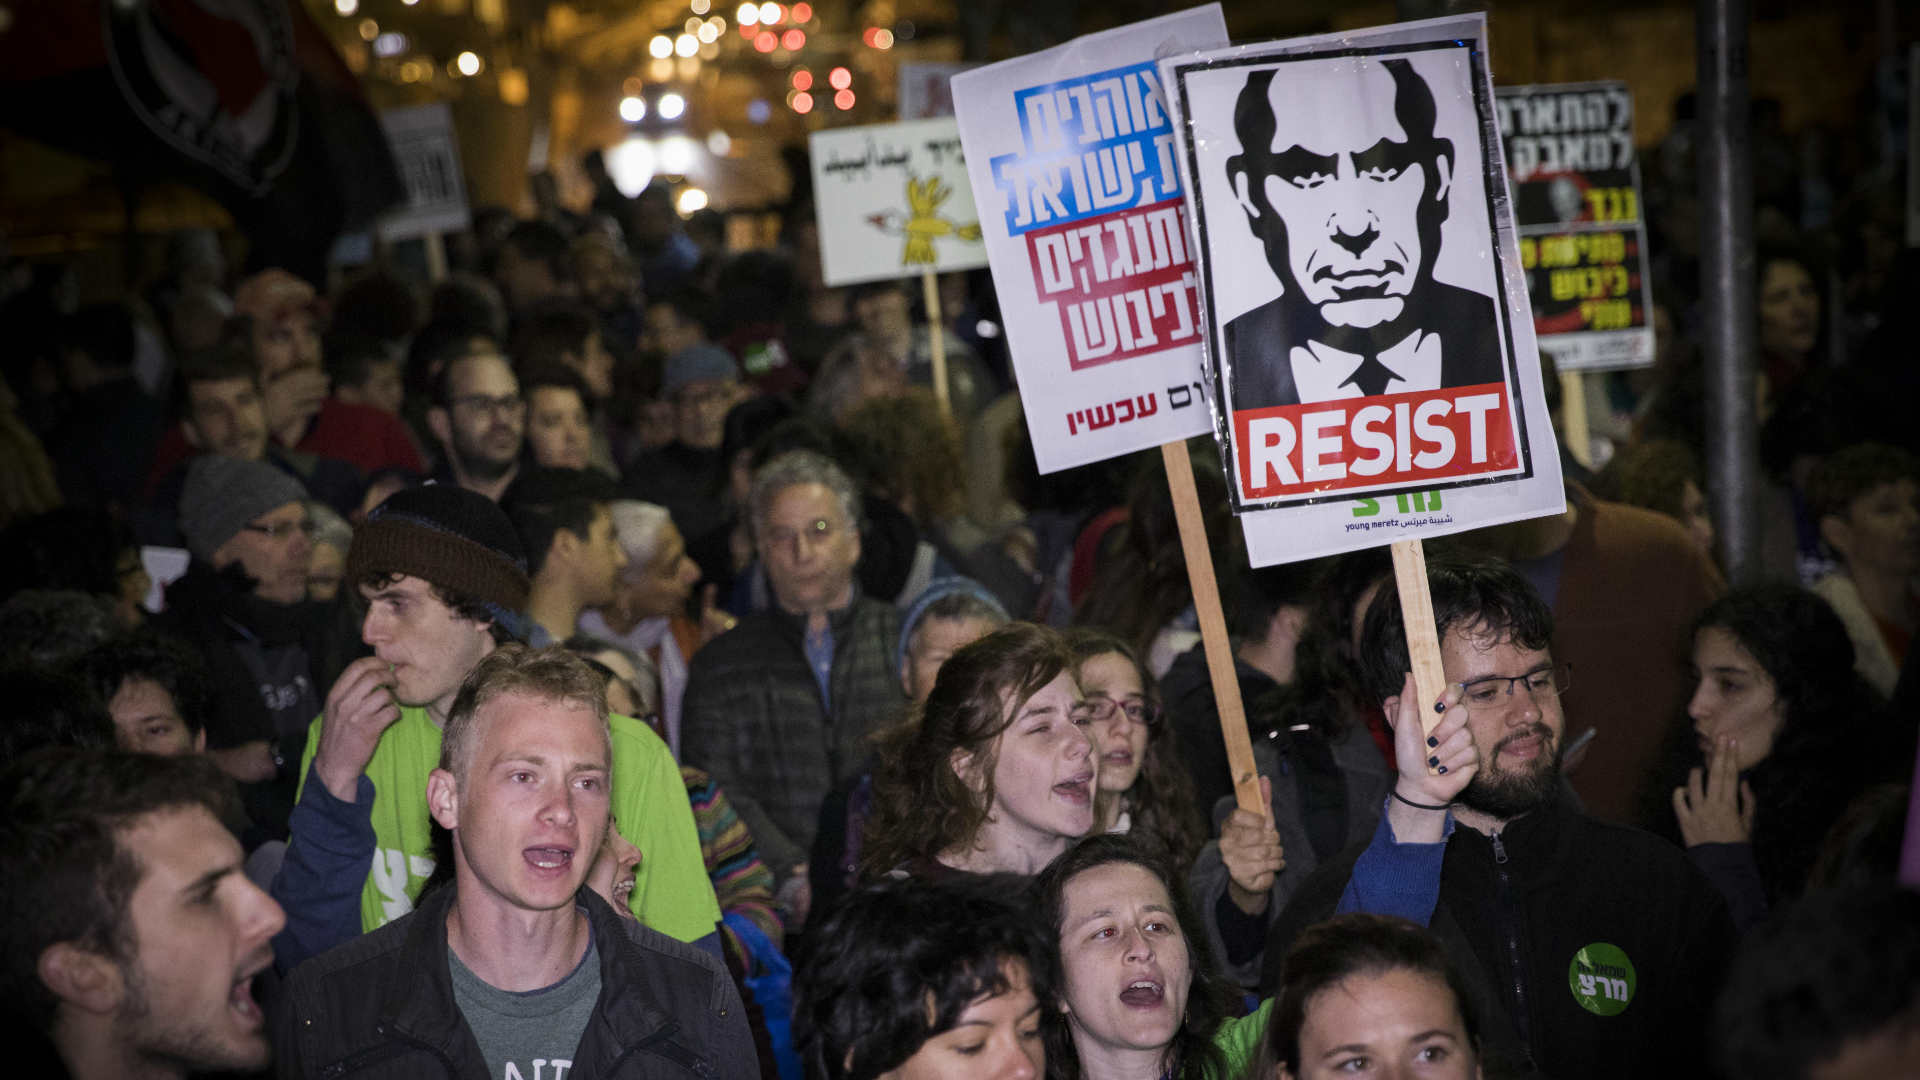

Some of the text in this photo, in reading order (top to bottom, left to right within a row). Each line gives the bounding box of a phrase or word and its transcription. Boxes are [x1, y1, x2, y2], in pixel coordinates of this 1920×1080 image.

[1023, 70, 1166, 153] אוהבים
[1497, 92, 1629, 136] להתארג
[1512, 130, 1632, 182] למאבק
[1001, 141, 1147, 227] ישראל
[1034, 206, 1194, 294] תנגדים
[1066, 393, 1158, 436] עכשיו
[1249, 393, 1500, 489] RESIST
[1345, 520, 1398, 532] young meretz
[1578, 973, 1628, 1002] מרצ
